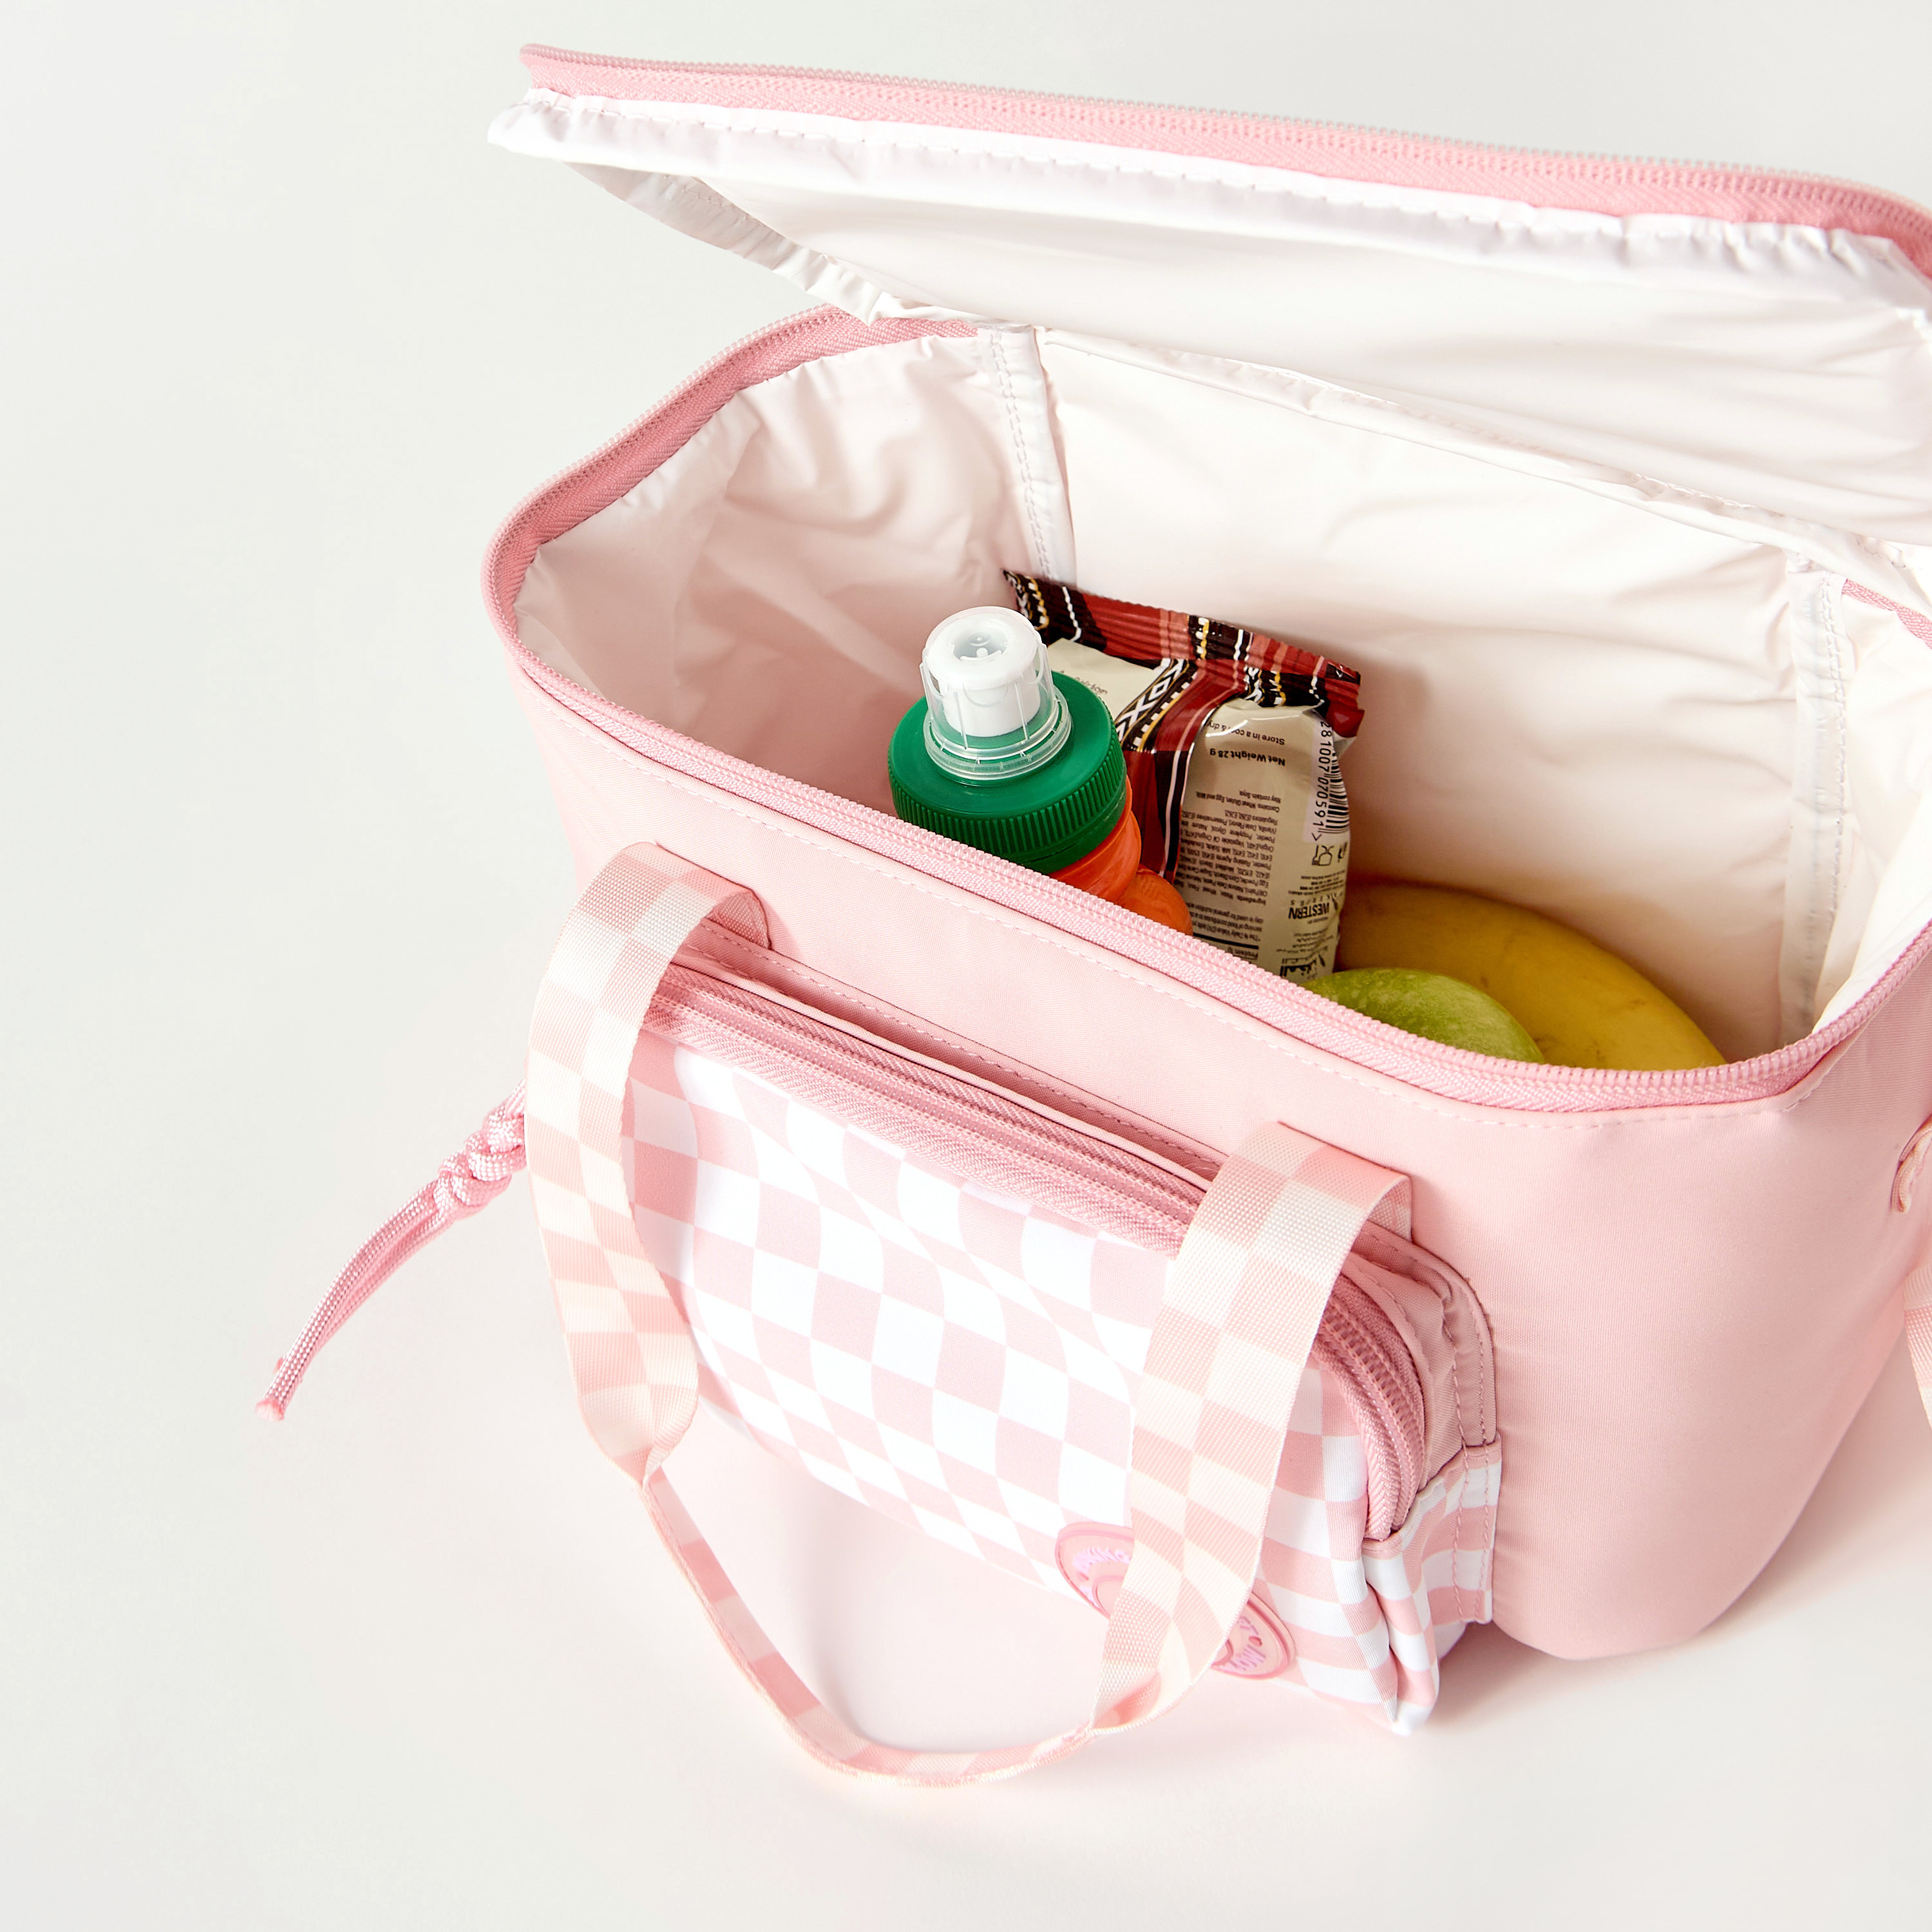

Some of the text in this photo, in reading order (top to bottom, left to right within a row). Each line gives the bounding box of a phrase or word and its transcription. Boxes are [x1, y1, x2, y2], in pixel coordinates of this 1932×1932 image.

[1253, 732, 1260, 741] in
[1262, 735, 1285, 746] Store
[1230, 751, 1266, 762] Weight
[1268, 755, 1285, 766] Net
[1312, 777, 1329, 828] 070591
[1289, 902, 1329, 920] WESTERN
